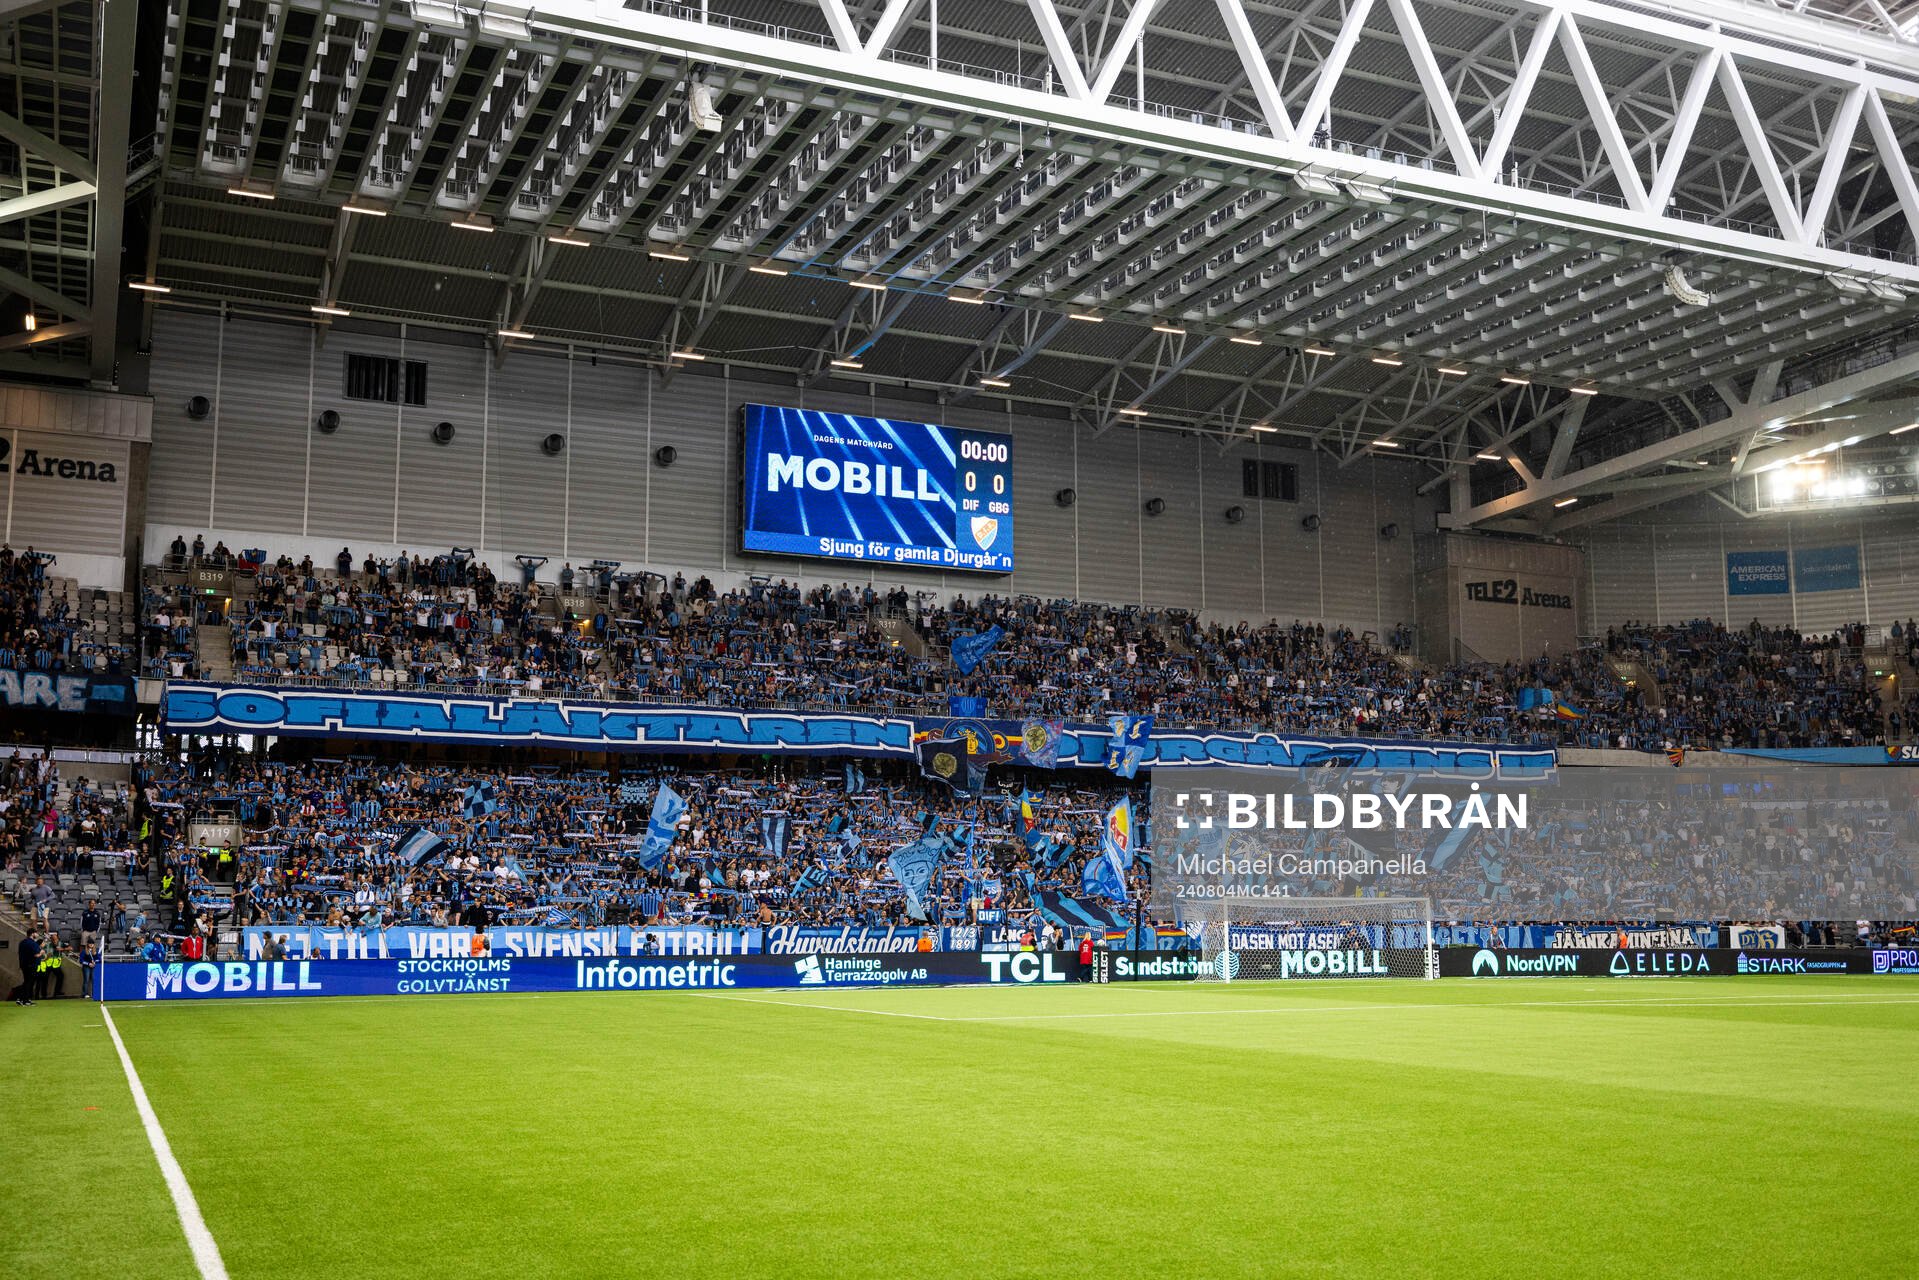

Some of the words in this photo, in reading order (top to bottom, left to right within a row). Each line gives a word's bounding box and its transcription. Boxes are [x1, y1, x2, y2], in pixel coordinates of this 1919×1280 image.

[813, 434, 845, 444] DAGENS
[961, 440, 1008, 463] 00:00
[17, 449, 117, 483] Arena
[767, 452, 941, 502] MOBILL
[965, 471, 976, 492] 0
[993, 474, 1004, 495] 0
[963, 498, 980, 511] DIF
[988, 501, 1010, 514] GBG
[819, 537, 864, 558] Sjung
[867, 541, 891, 557] för
[894, 545, 940, 564] gamla
[199, 571, 224, 581] B319
[1730, 564, 1785, 574] AMERICAN
[1738, 573, 1787, 582] EXPRESS
[564, 598, 585, 608] B318
[1465, 579, 1518, 605] TELE2
[1521, 587, 1572, 609] Arena
[200, 827, 231, 838] A119
[978, 910, 1000, 921] DIF!
[950, 927, 976, 939] 12/3
[408, 932, 471, 958] VAR
[950, 938, 977, 950] 1891
[397, 959, 511, 973] STOCKHOLMS
[825, 957, 881, 971] Haninge
[1100, 951, 1109, 983] SELECT
[1115, 956, 1215, 976] Sundström
[1280, 950, 1388, 979] MOBILL
[1506, 954, 1578, 972] NordVPN
[1636, 953, 1711, 972] ELEDA
[1748, 957, 1806, 973] STARK
[1890, 950, 1919, 966] PRO
[576, 959, 736, 988] Infometric
[826, 968, 907, 983] Terrazzogolv
[910, 968, 928, 980] AB
[981, 952, 1066, 983] TCL
[145, 961, 322, 999] MOBILL
[397, 973, 511, 993] GOLVTJÄNST
